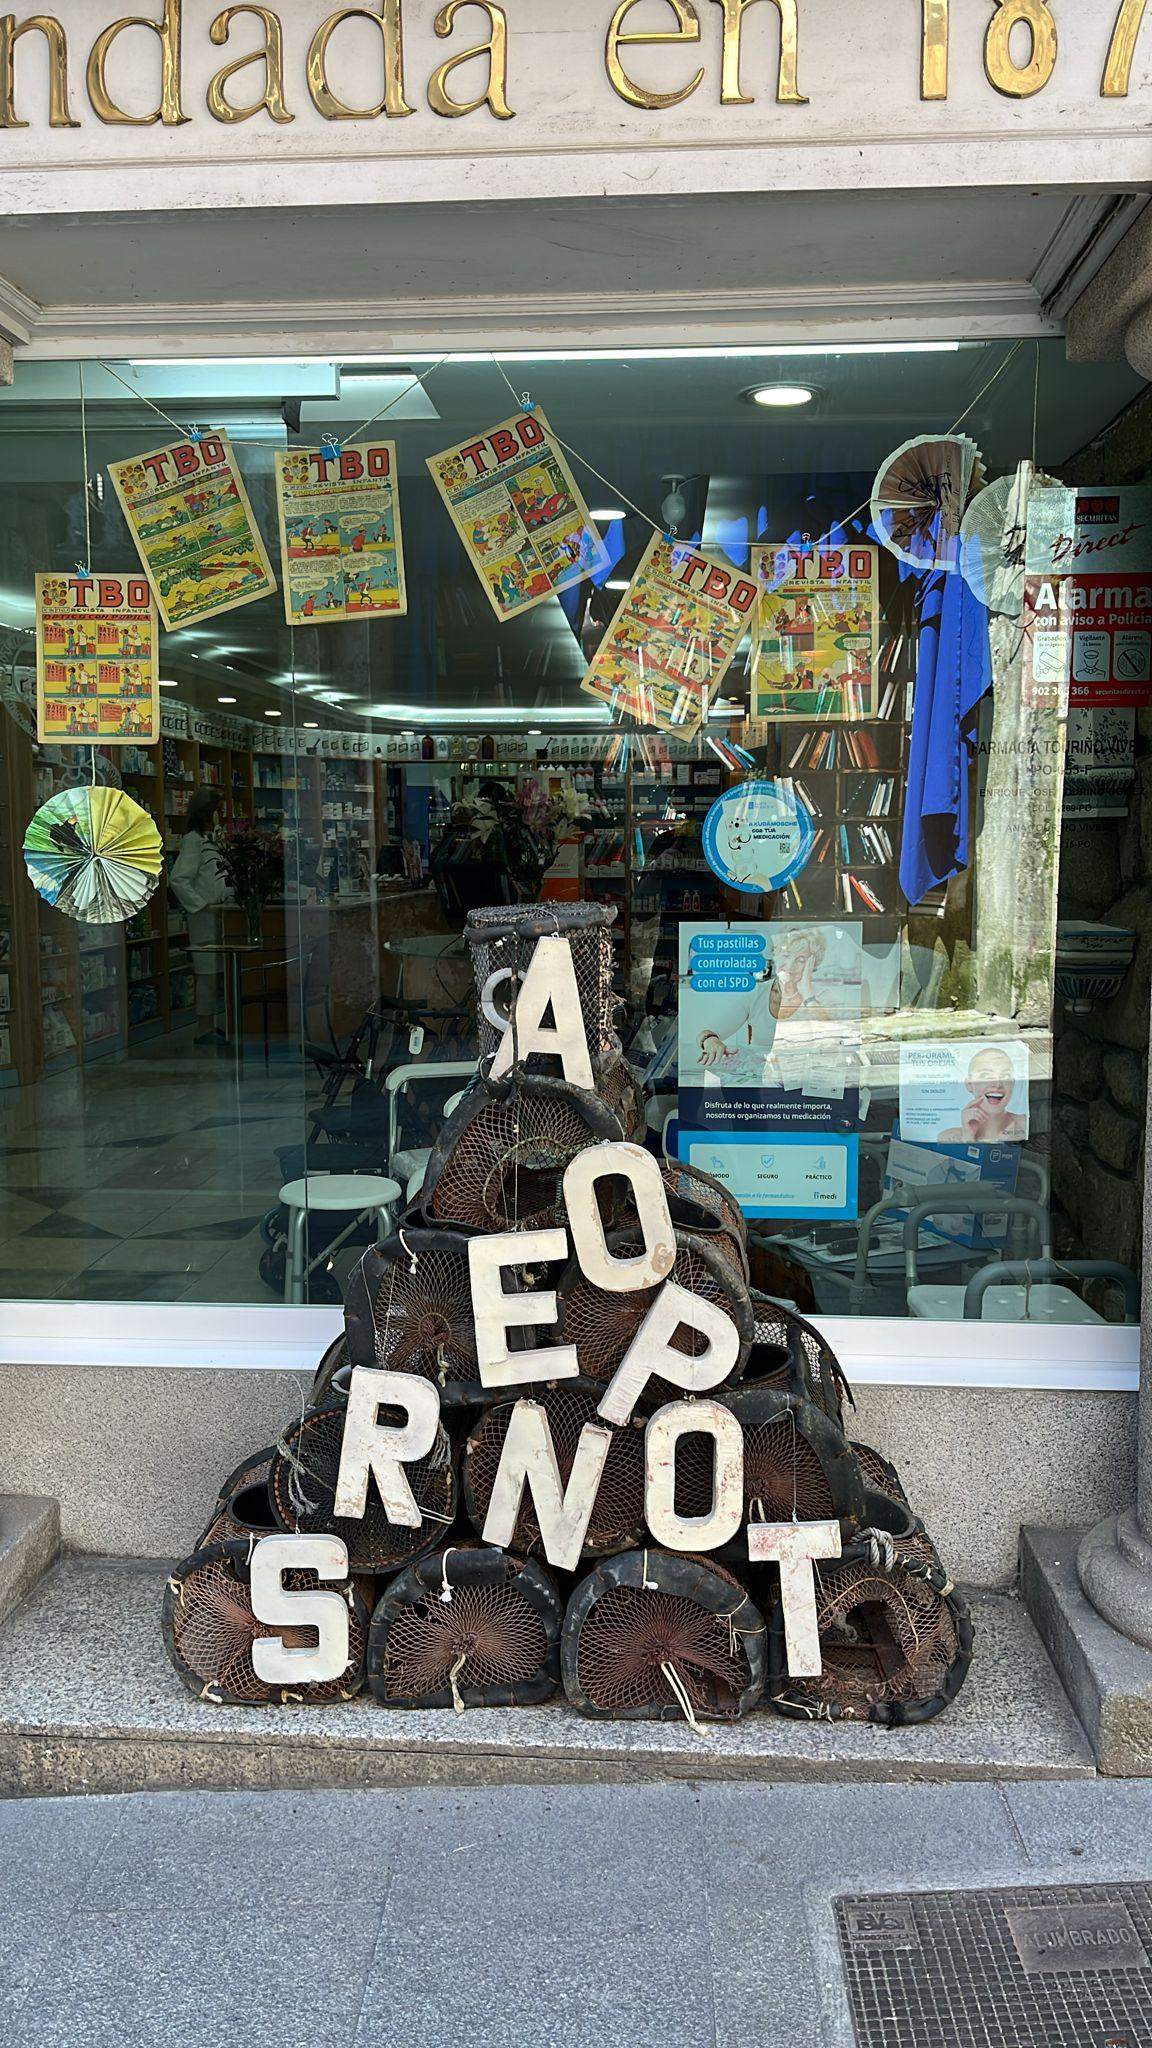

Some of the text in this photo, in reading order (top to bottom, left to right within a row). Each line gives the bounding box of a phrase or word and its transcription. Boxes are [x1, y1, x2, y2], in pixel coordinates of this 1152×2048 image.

[605, 0, 810, 110] en
[459, 416, 545, 475] TBO
[512, 442, 549, 462] INFANTIL
[142, 435, 226, 486] TBO
[192, 462, 228, 477] INFANTIL
[309, 448, 390, 482] TBO
[313, 481, 346, 489] REVISTA
[1076, 514, 1117, 522] SECURITAS
[1049, 523, 1146, 563] Direct
[788, 550, 872, 579] TBO
[677, 551, 758, 613] TBO
[68, 579, 150, 608] TBO
[1034, 581, 1152, 610] Alarma
[1034, 616, 1057, 626] con
[1061, 613, 1094, 626] aviso
[1097, 617, 1105, 625] a
[1032, 687, 1050, 696] 902
[1071, 687, 1090, 695] 366
[971, 741, 1040, 754] FARMACIA
[697, 937, 760, 951] Tus pastillas
[697, 957, 758, 968] controladas
[697, 977, 749, 987] con el SPD
[488, 936, 594, 1089] A
[704, 1102, 833, 1112] Disfruta de lo que realmente importa,
[737, 1112, 781, 1121] organizamos
[791, 1112, 831, 1120] medicación
[805, 1172, 833, 1180] PRÁCTICO
[467, 1228, 739, 1427] E P
[333, 1365, 440, 1529] R
[482, 1398, 613, 1572] N
[250, 1521, 841, 1684] S T
[1022, 1928, 1132, 1949] ALUMBRADO
